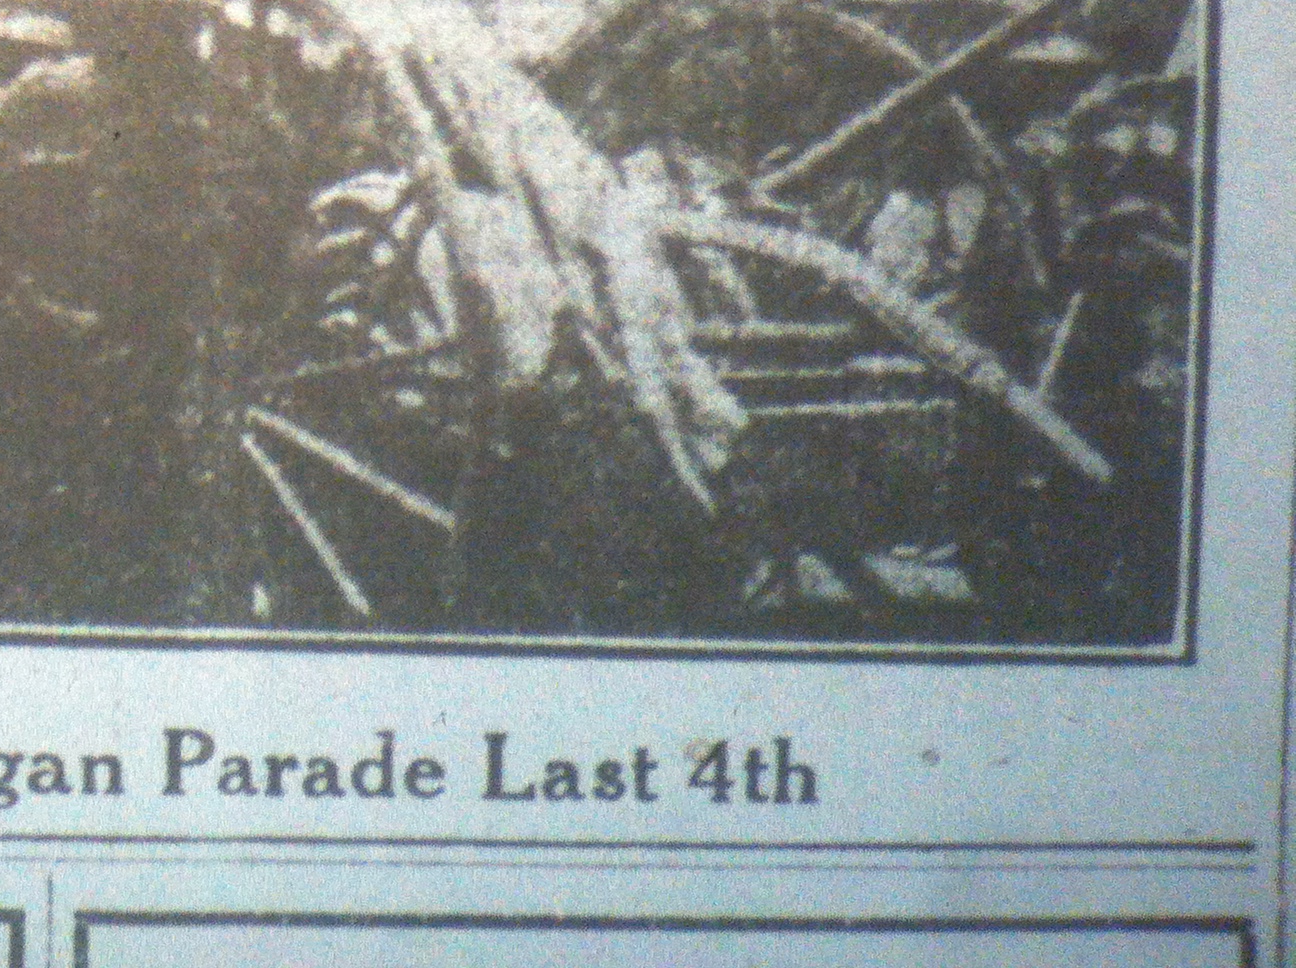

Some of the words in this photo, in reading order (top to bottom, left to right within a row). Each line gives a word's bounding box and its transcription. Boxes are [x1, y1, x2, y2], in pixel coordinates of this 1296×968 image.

[161, 725, 447, 802] Parade
[480, 729, 660, 805] Last
[684, 734, 820, 807] 4th
